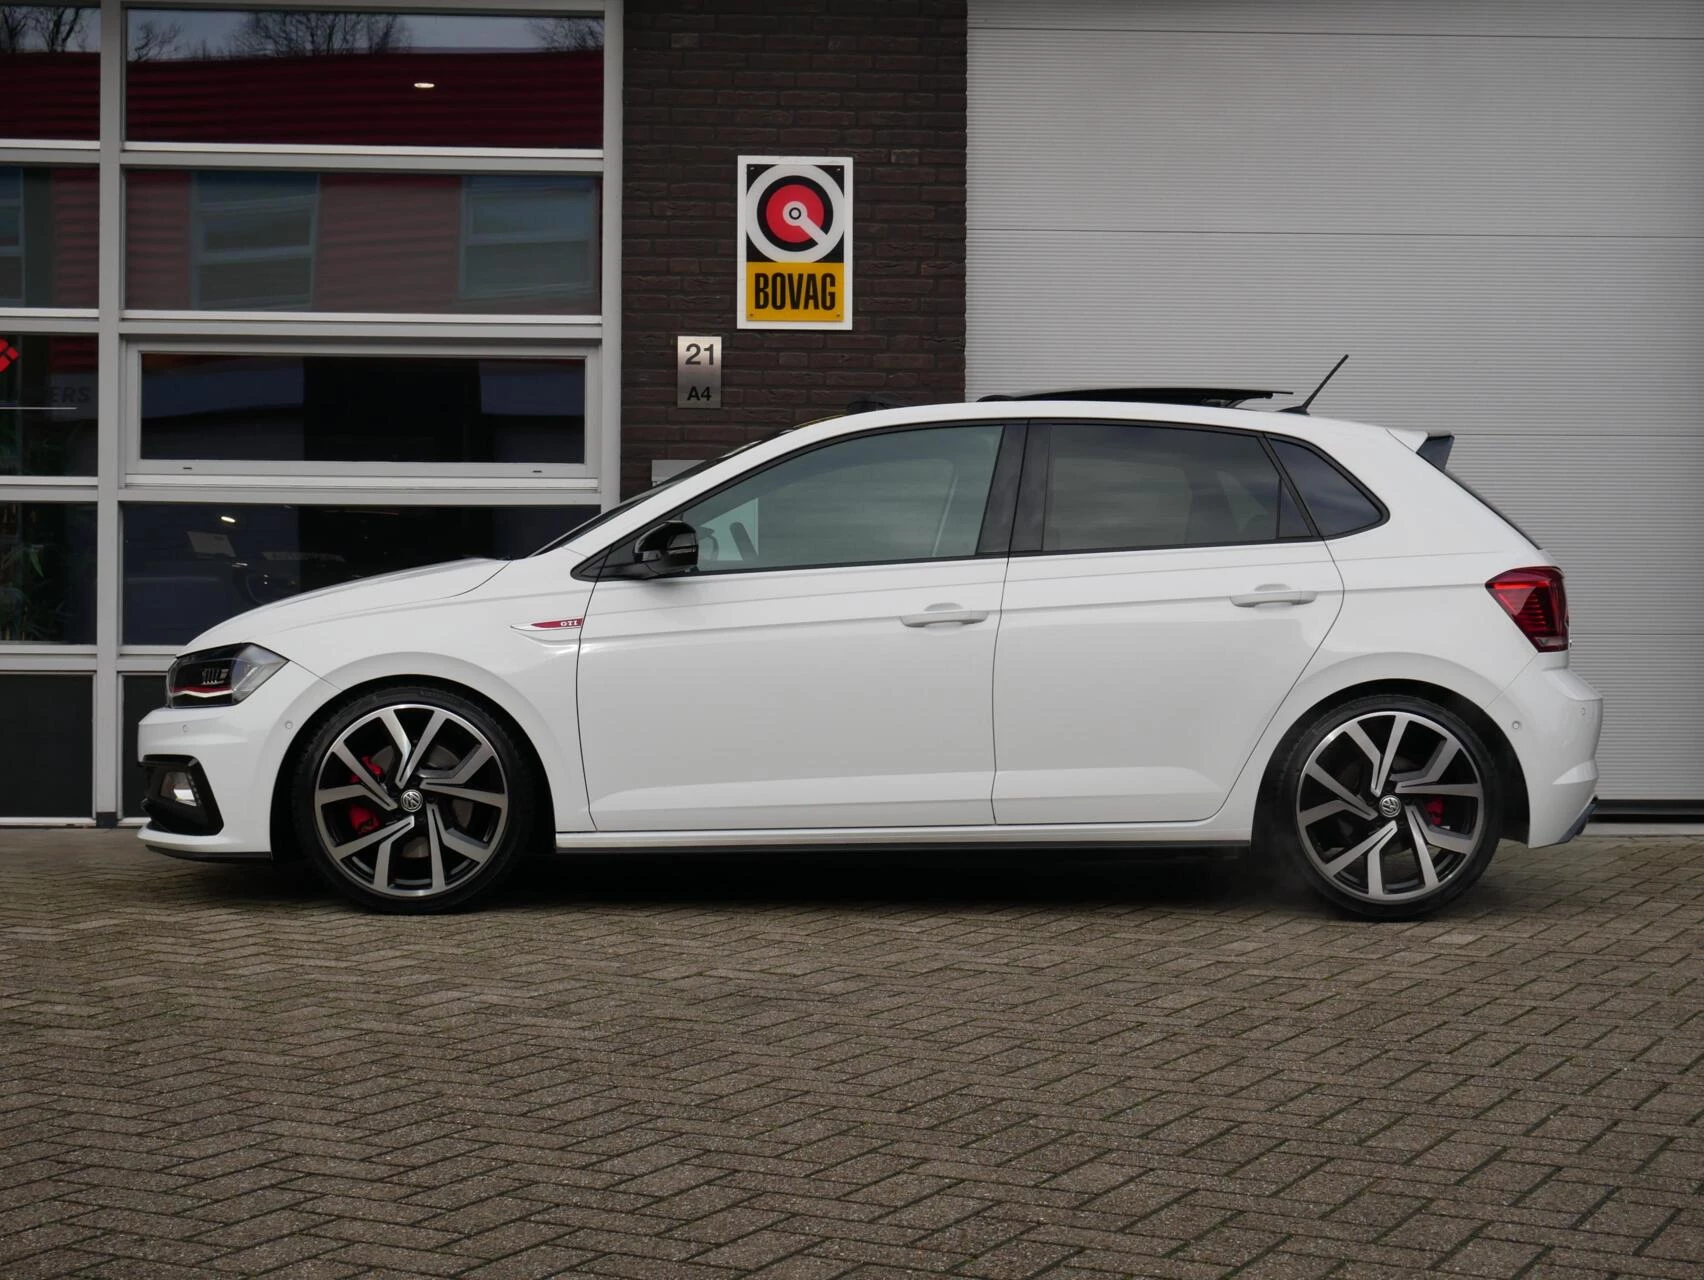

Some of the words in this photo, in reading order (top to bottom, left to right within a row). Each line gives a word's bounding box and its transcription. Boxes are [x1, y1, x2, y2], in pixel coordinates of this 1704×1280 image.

[754, 272, 836, 311] BOVAG
[685, 343, 715, 365] 21
[687, 386, 712, 401] A4
